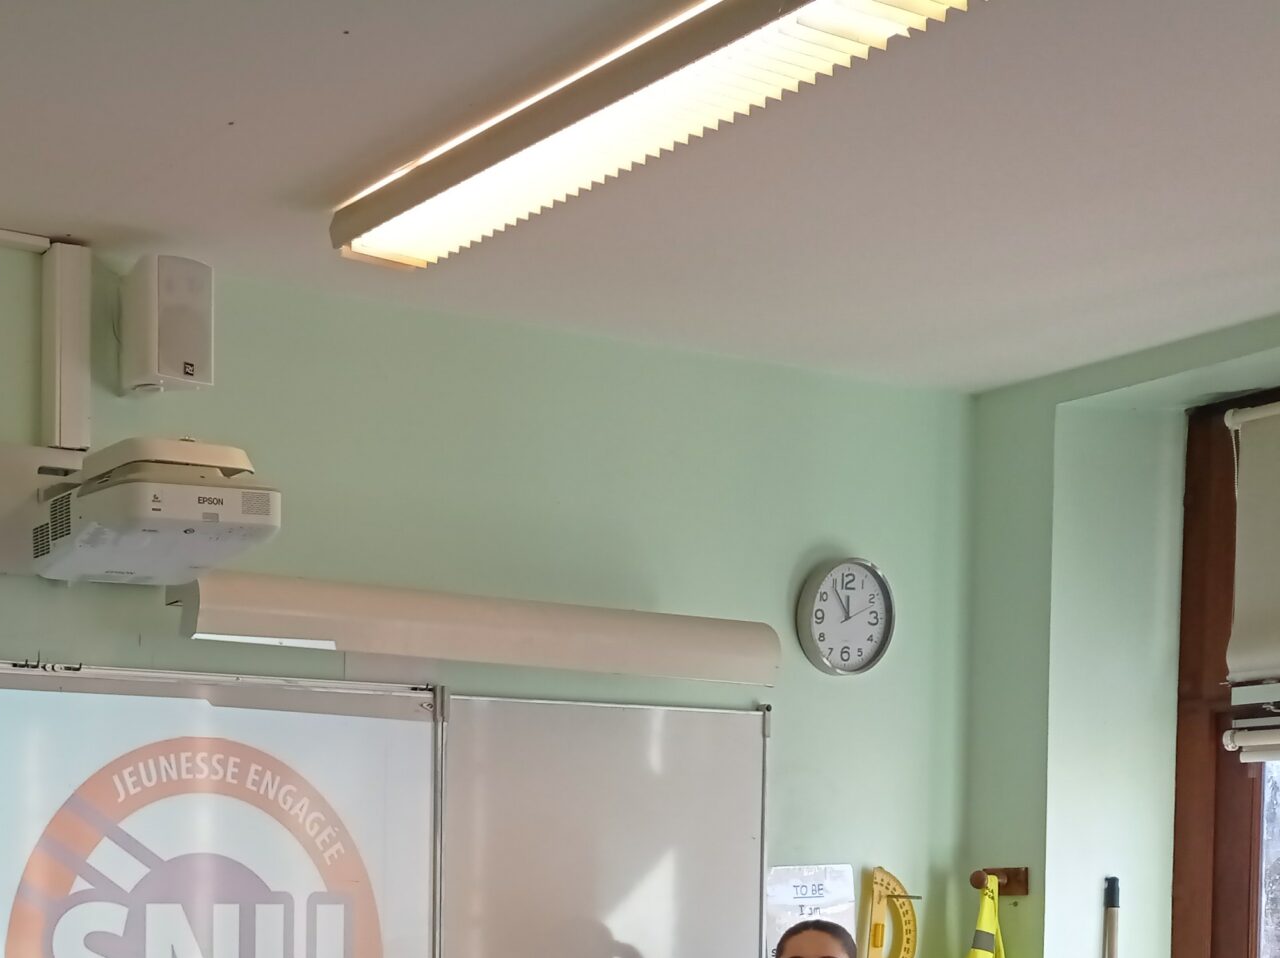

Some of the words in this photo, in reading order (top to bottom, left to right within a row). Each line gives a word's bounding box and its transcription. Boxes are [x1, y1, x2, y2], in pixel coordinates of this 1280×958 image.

[197, 496, 224, 506] EPSON
[841, 572, 856, 591] 12
[819, 591, 829, 602] 10
[868, 593, 876, 605] 2
[814, 608, 825, 625] 9
[867, 610, 880, 626] 3
[817, 632, 826, 643] 8
[866, 634, 874, 643] 4
[827, 647, 834, 657] 7
[840, 646, 851, 662] 6
[857, 648, 864, 658] 5
[112, 751, 241, 803] JEUNESSE
[246, 763, 345, 866] ENGAGÉE
[793, 884, 808, 896] TO
[811, 883, 824, 896] BE
